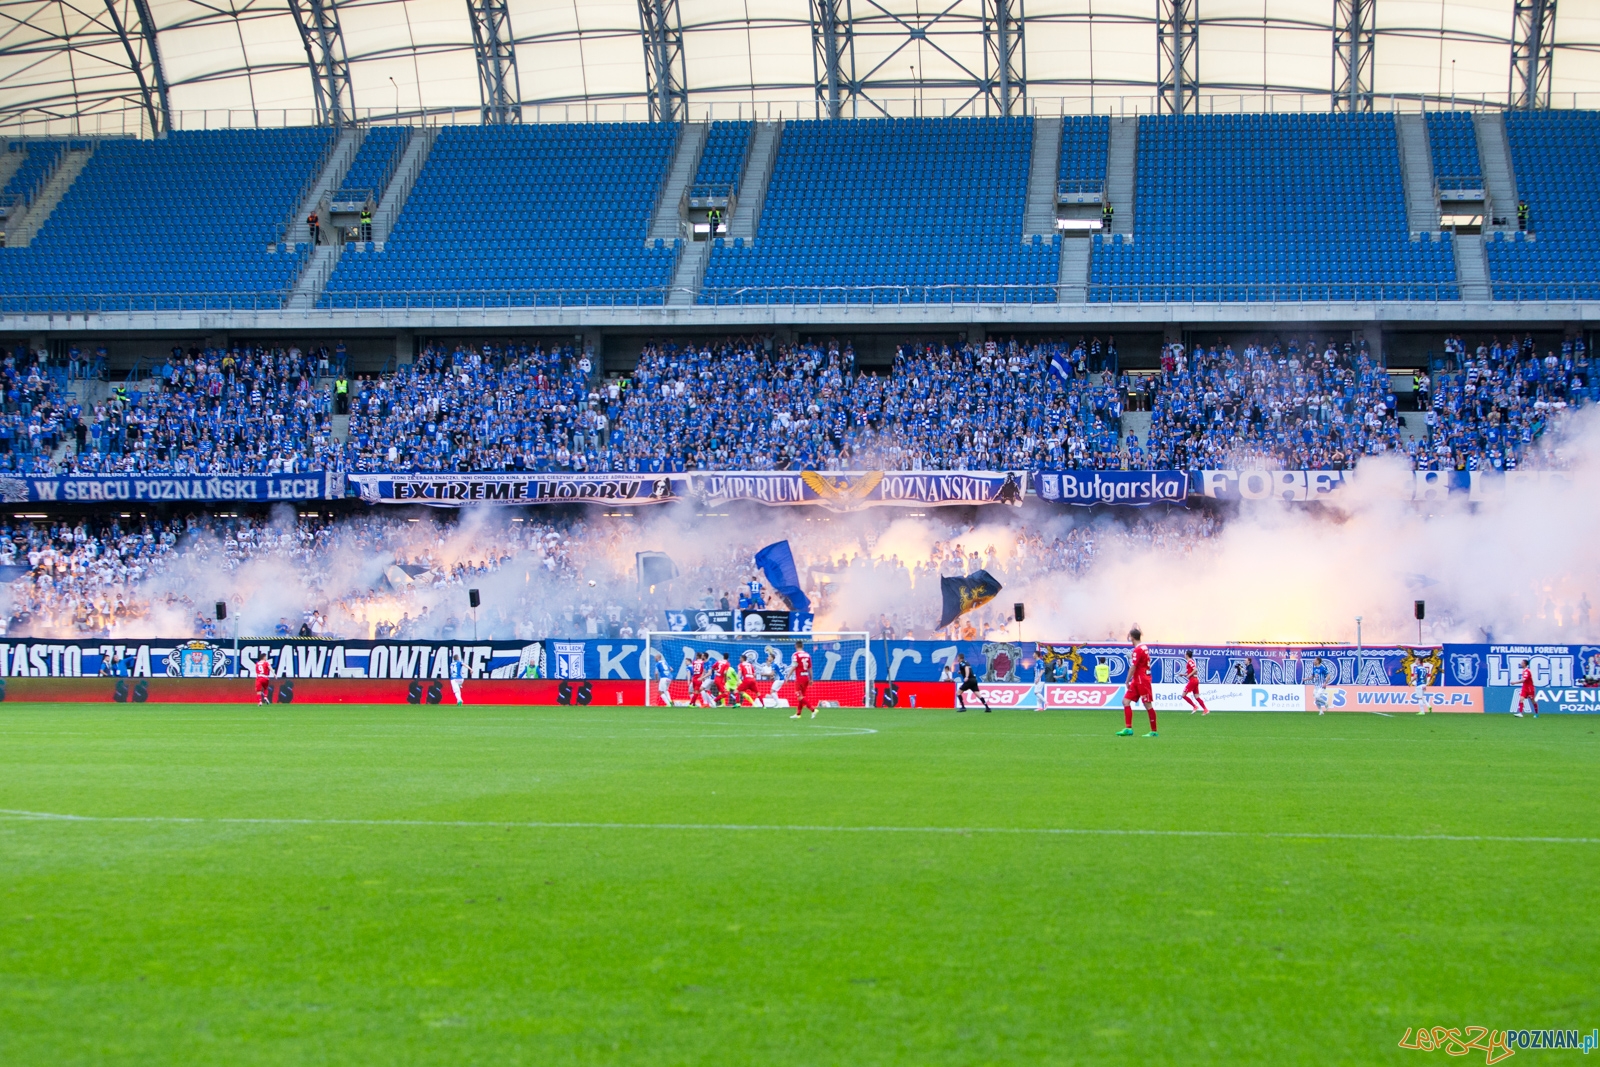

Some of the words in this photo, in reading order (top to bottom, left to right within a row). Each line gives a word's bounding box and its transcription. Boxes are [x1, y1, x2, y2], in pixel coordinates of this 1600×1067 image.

[34, 481, 59, 500] W
[64, 480, 129, 500] SERCU
[135, 477, 257, 500] POZNAŃSKI
[267, 479, 320, 499] LECH
[394, 482, 528, 500] EXTREME
[711, 477, 805, 501] IMPERIUM
[881, 475, 992, 501] POZNAŃSKIE
[1062, 473, 1179, 502] Bułgarska
[1202, 470, 1449, 501] FORER
[1149, 648, 1177, 656] NASZEJ
[1178, 648, 1201, 656] MAEJ
[1301, 649, 1325, 657] WIELKI
[1327, 649, 1346, 657] LECH
[1490, 645, 1532, 654] PYRLANDIA
[1534, 646, 1569, 654] FOREVER
[1095, 655, 1391, 686] PRLANDIA
[1486, 654, 1575, 687] LECH
[557, 682, 593, 706] STS
[1051, 687, 1101, 704] tesa
[1155, 693, 1183, 702] Radio
[1272, 693, 1300, 701] Radio
